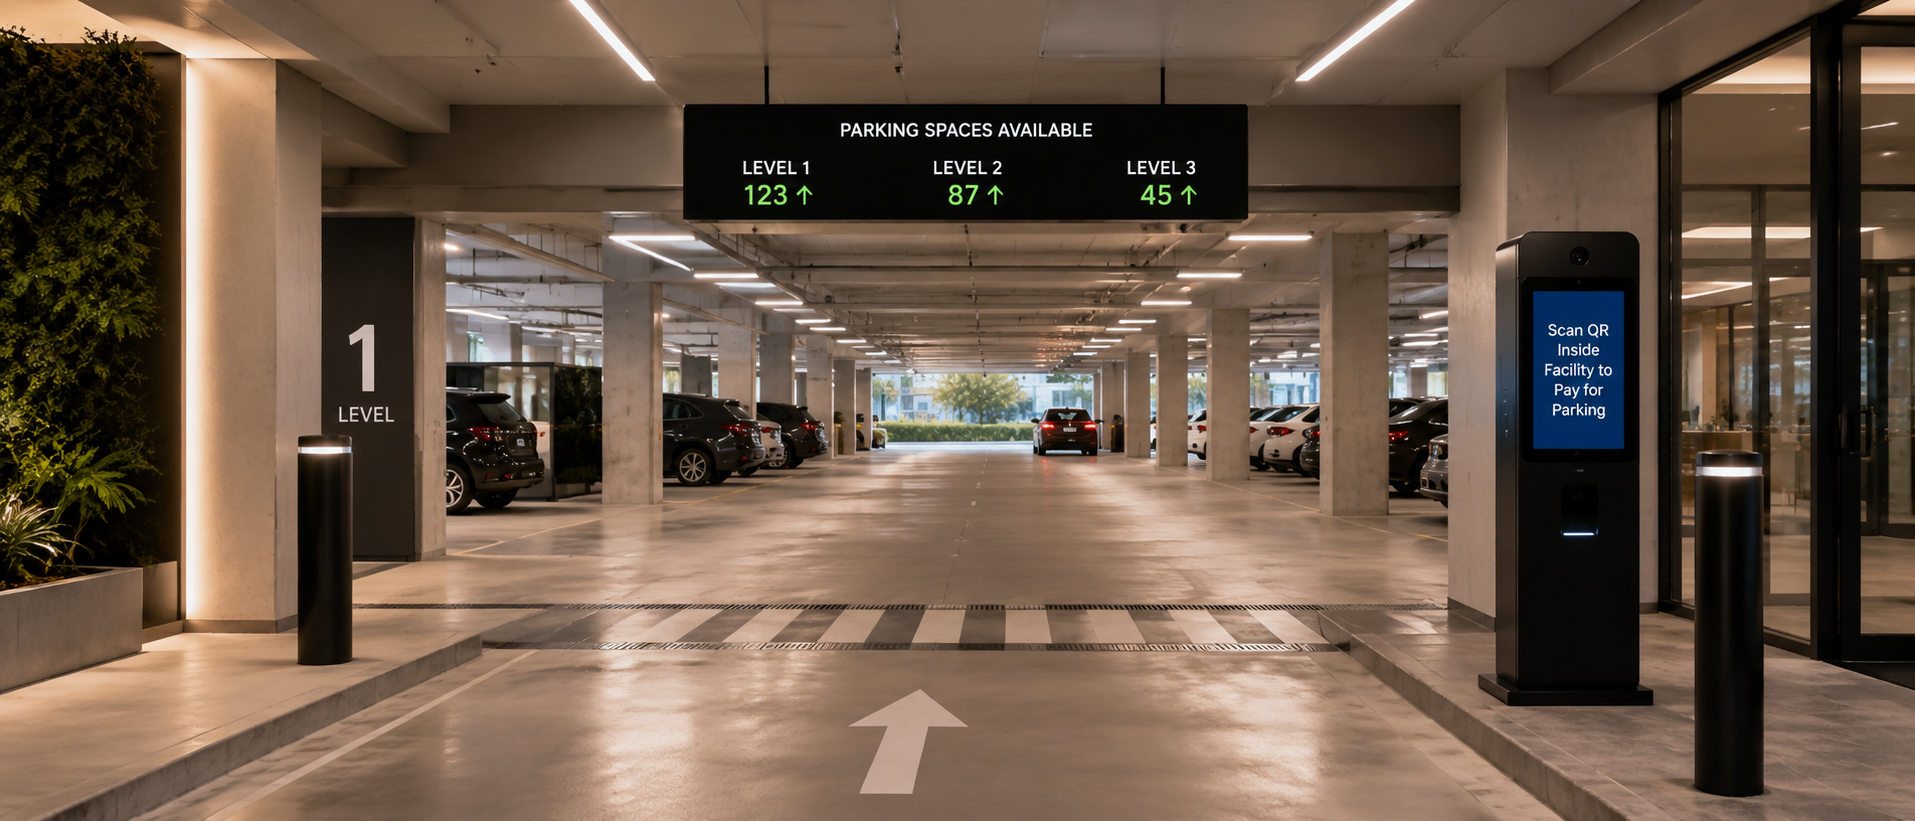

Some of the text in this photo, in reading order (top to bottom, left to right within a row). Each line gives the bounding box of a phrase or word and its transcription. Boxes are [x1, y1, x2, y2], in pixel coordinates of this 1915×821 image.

[840, 122, 1093, 138] PARKING SPACES AVAILABLE
[742, 160, 810, 176] LEVEL 1
[933, 160, 1003, 176] LEVEL 2
[1127, 160, 1196, 176] LEVEL 3
[744, 185, 788, 206] 123
[948, 185, 979, 206] 87
[1140, 185, 1172, 206] 45
[1548, 323, 1609, 338] Scan QR
[348, 324, 375, 392] 1
[1557, 342, 1600, 357] Inside
[1544, 362, 1613, 379] Facility to
[1554, 382, 1604, 399] Pay for
[338, 406, 395, 423] LEVEL
[1552, 402, 1606, 420] Parking
